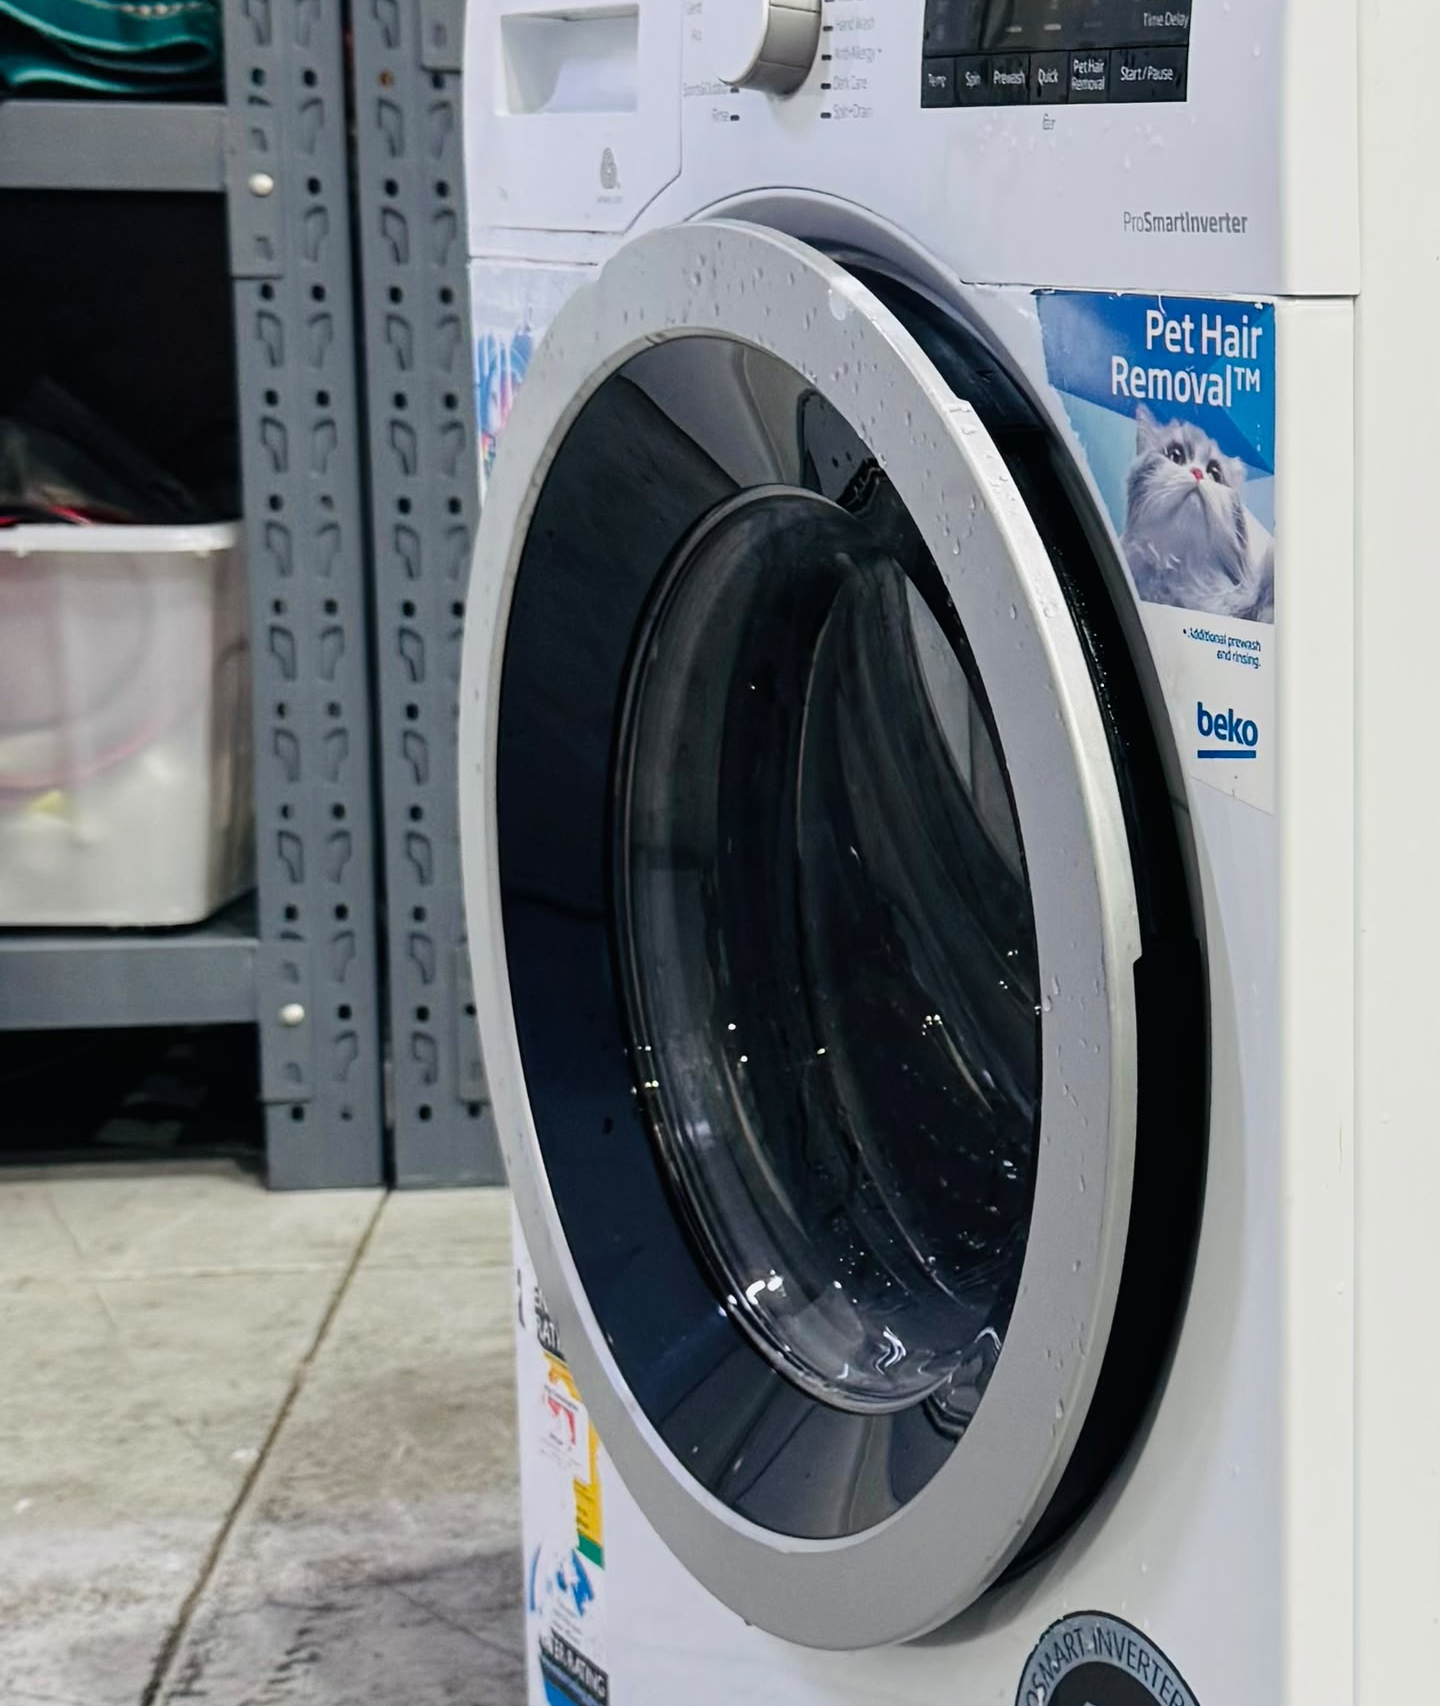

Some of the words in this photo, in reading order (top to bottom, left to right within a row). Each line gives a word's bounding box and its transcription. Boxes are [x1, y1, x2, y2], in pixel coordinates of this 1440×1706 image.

[1143, 12, 1164, 28] Time
[1165, 12, 1189, 29] Delay
[1073, 59, 1087, 73] Pet
[1088, 58, 1105, 72] Hair
[993, 70, 1026, 85] Prewash
[1037, 68, 1059, 85] Quick
[1071, 75, 1106, 91] Removal
[1123, 210, 1249, 234] ProSmartInverter
[1145, 308, 1195, 356] Pet
[1200, 312, 1263, 361] Hair
[1227, 635, 1262, 652] prewash
[1216, 649, 1232, 662] and
[1196, 701, 1259, 748] beko
